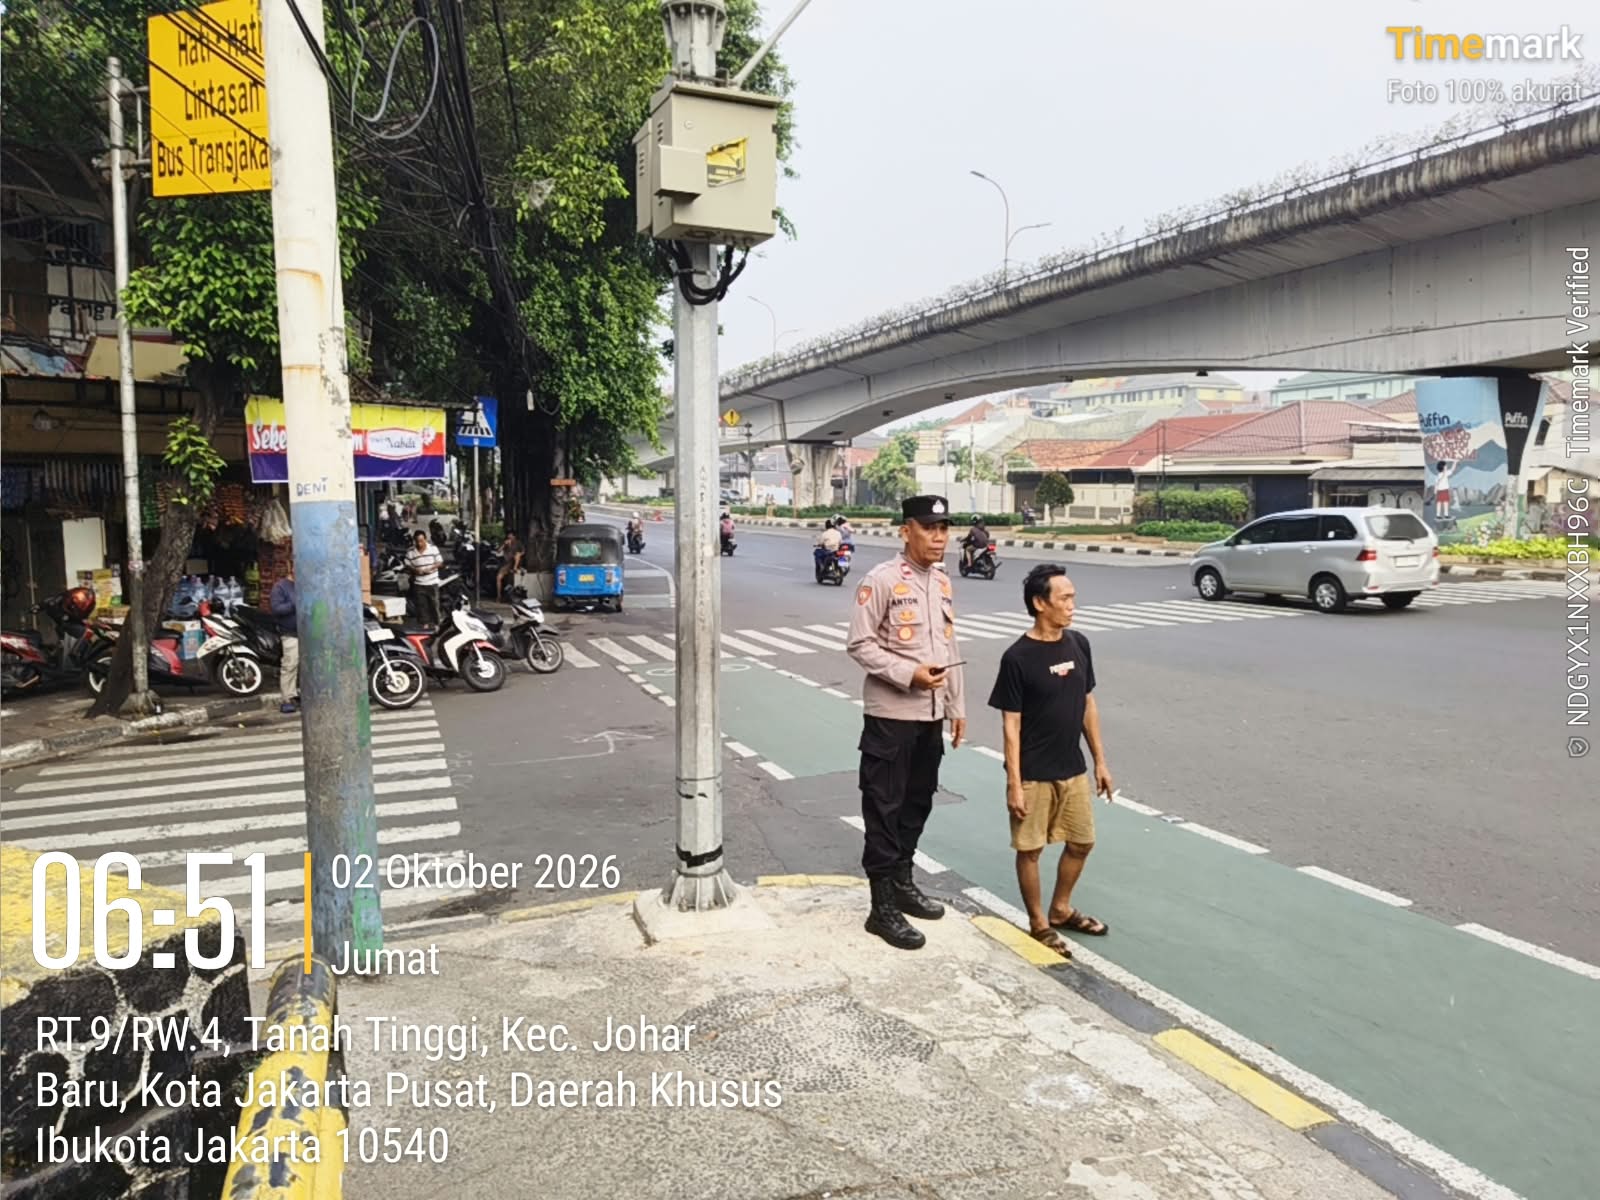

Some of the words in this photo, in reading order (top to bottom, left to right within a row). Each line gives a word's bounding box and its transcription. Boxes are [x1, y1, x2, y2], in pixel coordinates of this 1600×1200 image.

[177, 24, 211, 67] Hati
[227, 15, 263, 57] Hati
[184, 79, 260, 121] Lintasan
[157, 140, 184, 178] Bus
[189, 129, 269, 184] Transjaka
[252, 417, 288, 452] Seke
[891, 597, 918, 607] ANTON
